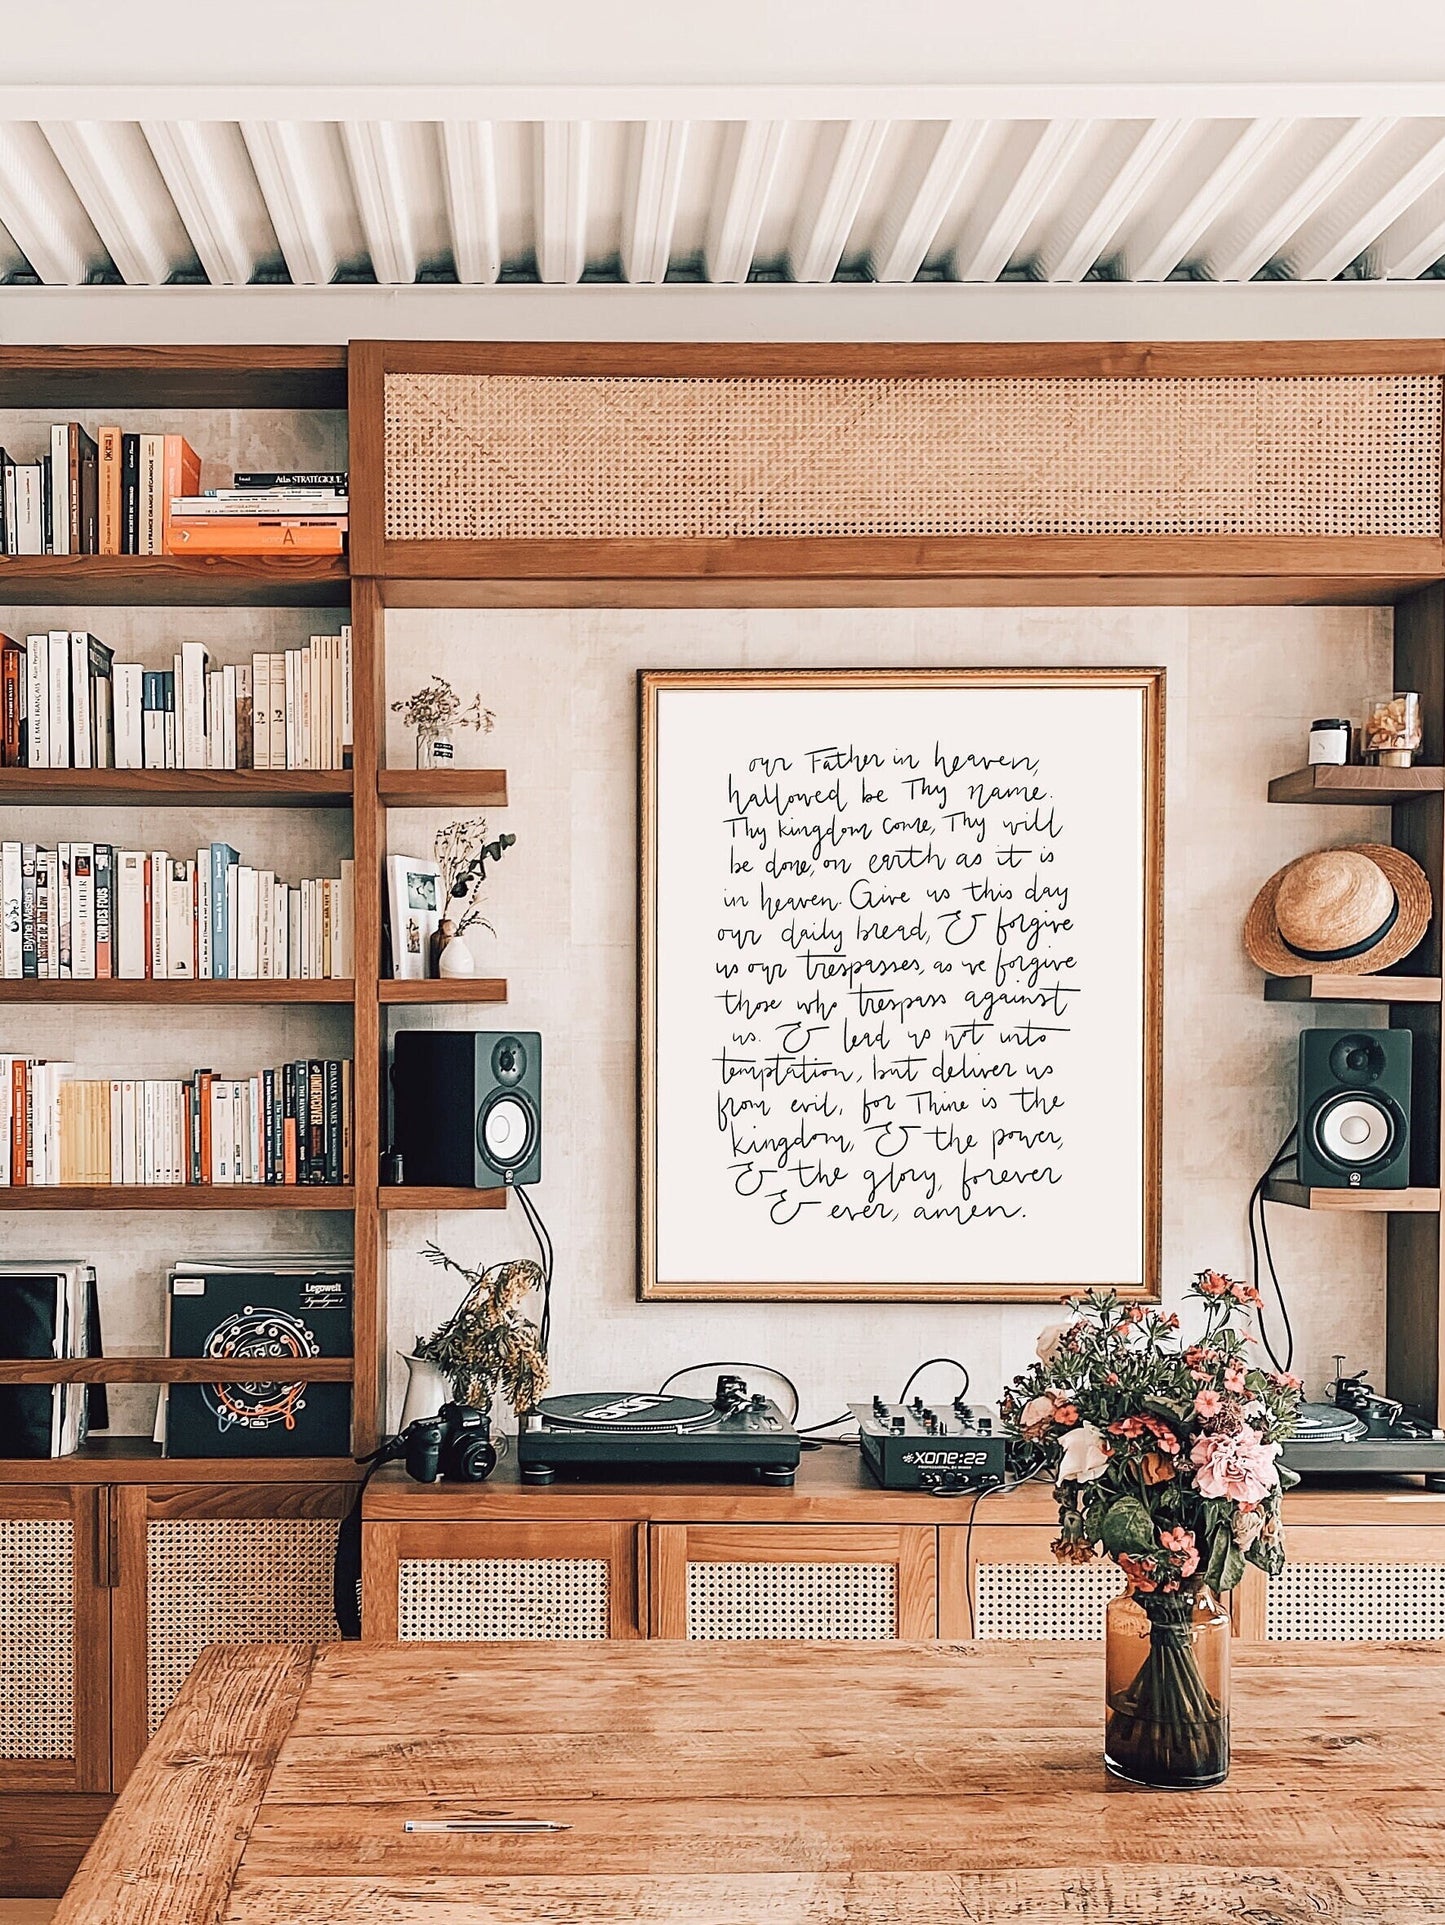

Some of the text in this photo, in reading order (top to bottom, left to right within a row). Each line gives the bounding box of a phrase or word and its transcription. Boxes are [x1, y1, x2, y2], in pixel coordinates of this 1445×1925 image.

[749, 740, 1039, 777] our Father in heaven,
[728, 773, 1053, 815] hallowed be Thy name.
[723, 817, 767, 850] Thy
[778, 815, 872, 860] kingdom
[942, 811, 986, 842] Thy
[1003, 806, 1063, 838] will
[731, 842, 1054, 878] be done, on earth as it is
[96, 887, 109, 908] FOUS
[724, 872, 1069, 920] in heaven. Give us this day
[23, 888, 35, 951] Blythe Masters
[717, 928, 762, 949] our
[781, 918, 843, 952] daily
[856, 911, 930, 944] bread,
[996, 906, 1074, 950] forgive
[716, 946, 1078, 989] us our trespasses, as we forgive
[714, 980, 1081, 1023] those who trespass against
[732, 1029, 761, 1046] us.
[844, 1017, 890, 1053] lead
[908, 1029, 930, 1049] us
[945, 1019, 994, 1049] not
[1000, 1019, 1071, 1047] into
[712, 1046, 1054, 1092] temptation, but deliver us
[310, 1073, 323, 1124] UNDERCOVER
[717, 1086, 1065, 1131] from evil, for Thine is the
[731, 1117, 854, 1169] kingdom,
[923, 1123, 978, 1153] the
[992, 1128, 1063, 1160] power,
[787, 1158, 849, 1187] the
[863, 1162, 942, 1203] glory,
[962, 1158, 1062, 1201] forever
[827, 1203, 899, 1222] ever,
[914, 1204, 1026, 1225] amen.
